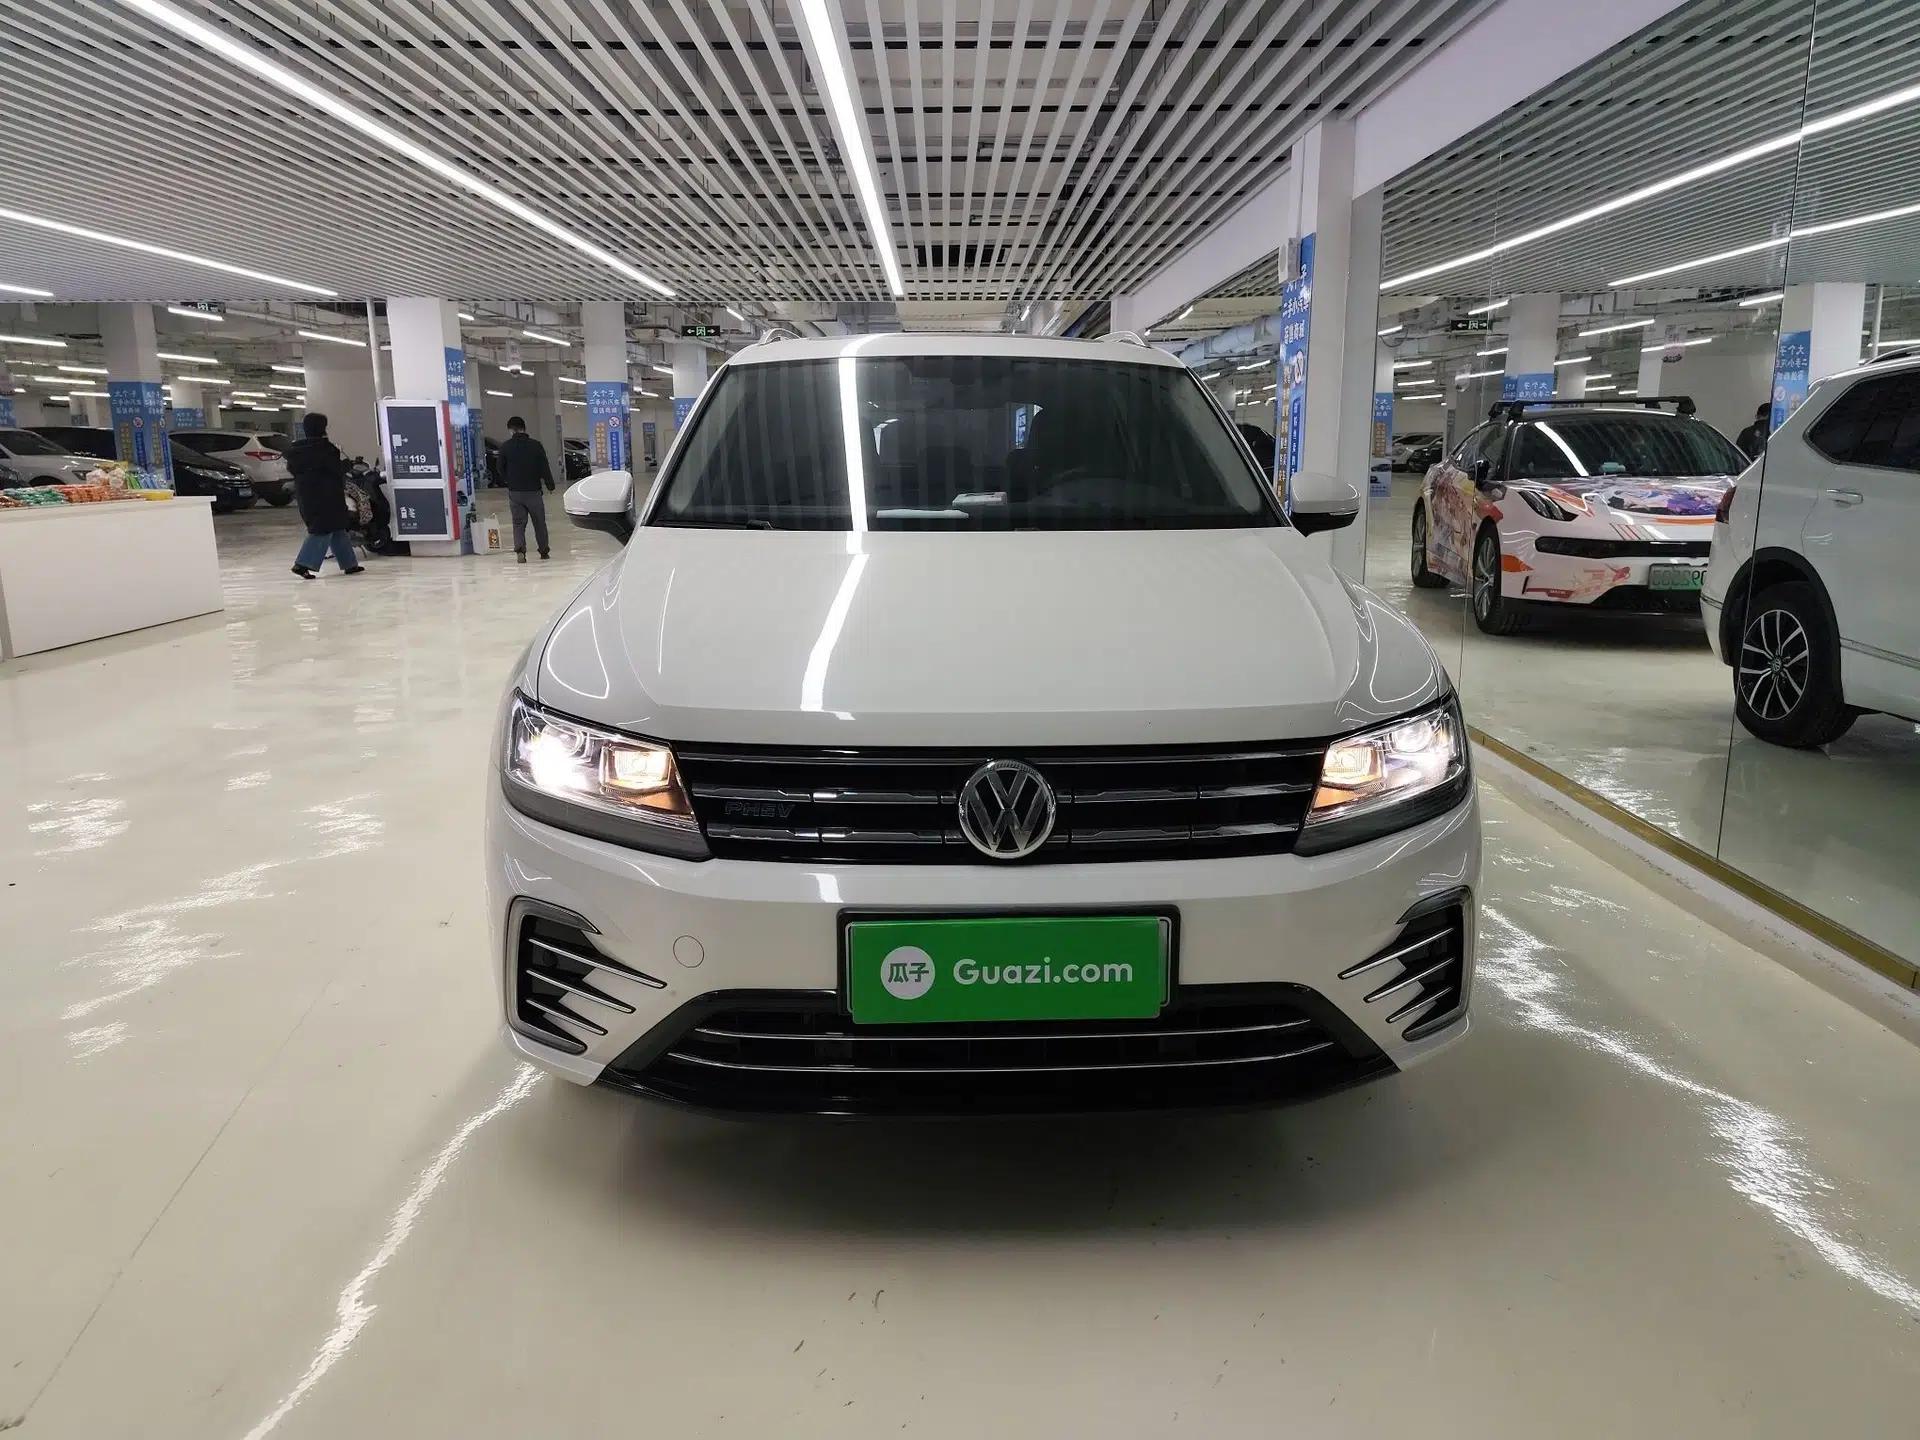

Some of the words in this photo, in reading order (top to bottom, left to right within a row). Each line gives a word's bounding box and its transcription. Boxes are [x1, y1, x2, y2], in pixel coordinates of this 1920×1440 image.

[592, 389, 615, 397] 大个子
[409, 454, 426, 463] 119
[724, 801, 796, 818] PHEV
[887, 962, 930, 983] 瓜子
[952, 956, 1133, 985] Guazi.com
